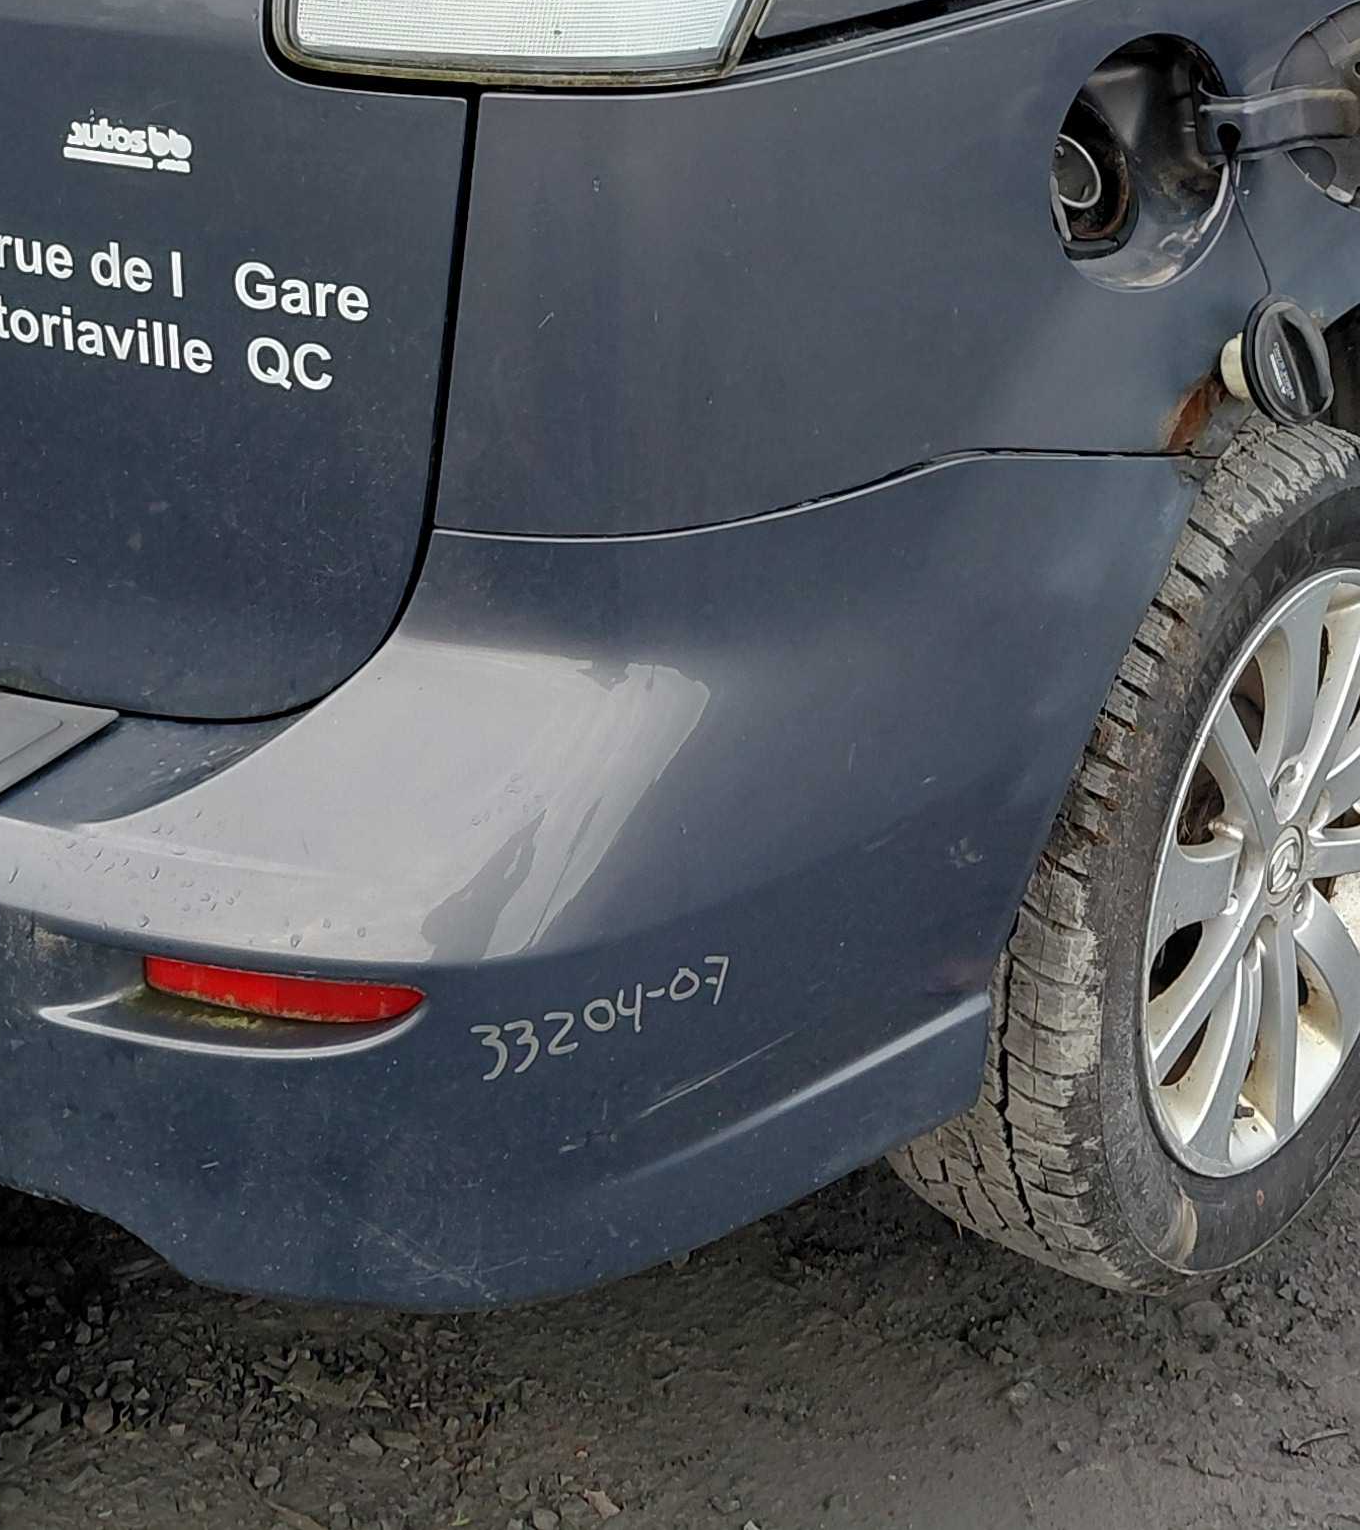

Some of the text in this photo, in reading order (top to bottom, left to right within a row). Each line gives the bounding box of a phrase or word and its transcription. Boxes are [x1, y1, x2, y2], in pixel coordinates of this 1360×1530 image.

[90, 241, 154, 293] de
[234, 261, 370, 322] Gare
[246, 335, 334, 391] QC
[469, 954, 730, 1081] 33204-07
